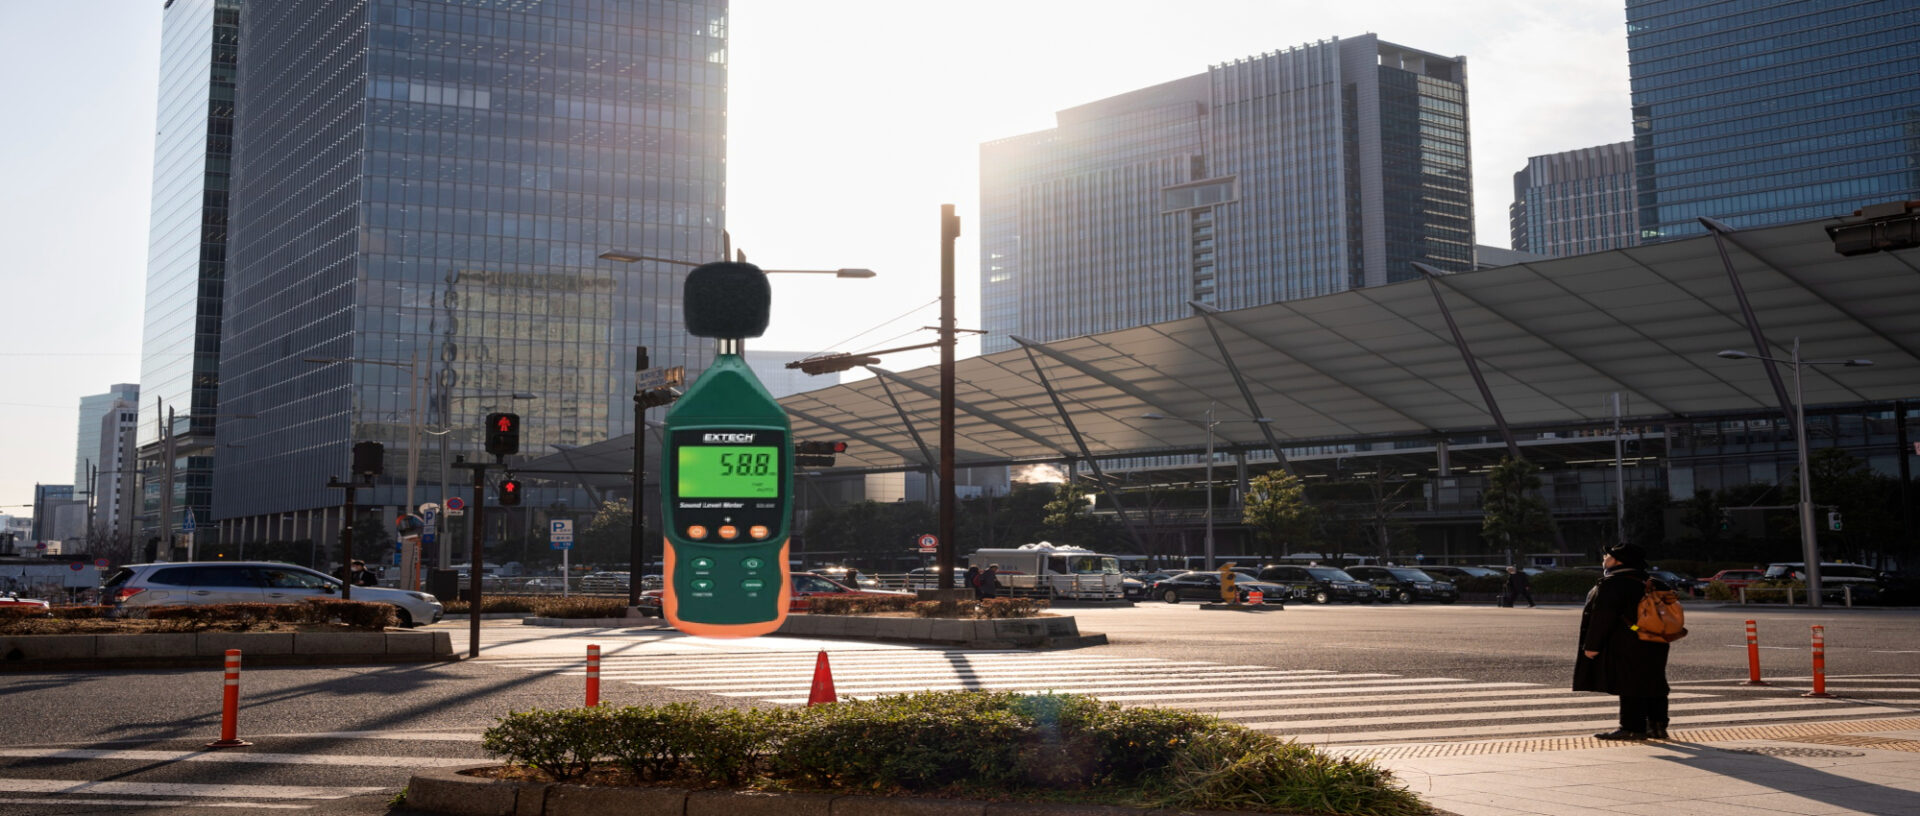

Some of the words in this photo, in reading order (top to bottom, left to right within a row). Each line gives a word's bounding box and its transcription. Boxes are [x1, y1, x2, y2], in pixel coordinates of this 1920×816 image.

[703, 433, 754, 443] EXTECH
[720, 453, 771, 476] 58.8
[426, 511, 433, 524] P
[553, 522, 565, 532] P
